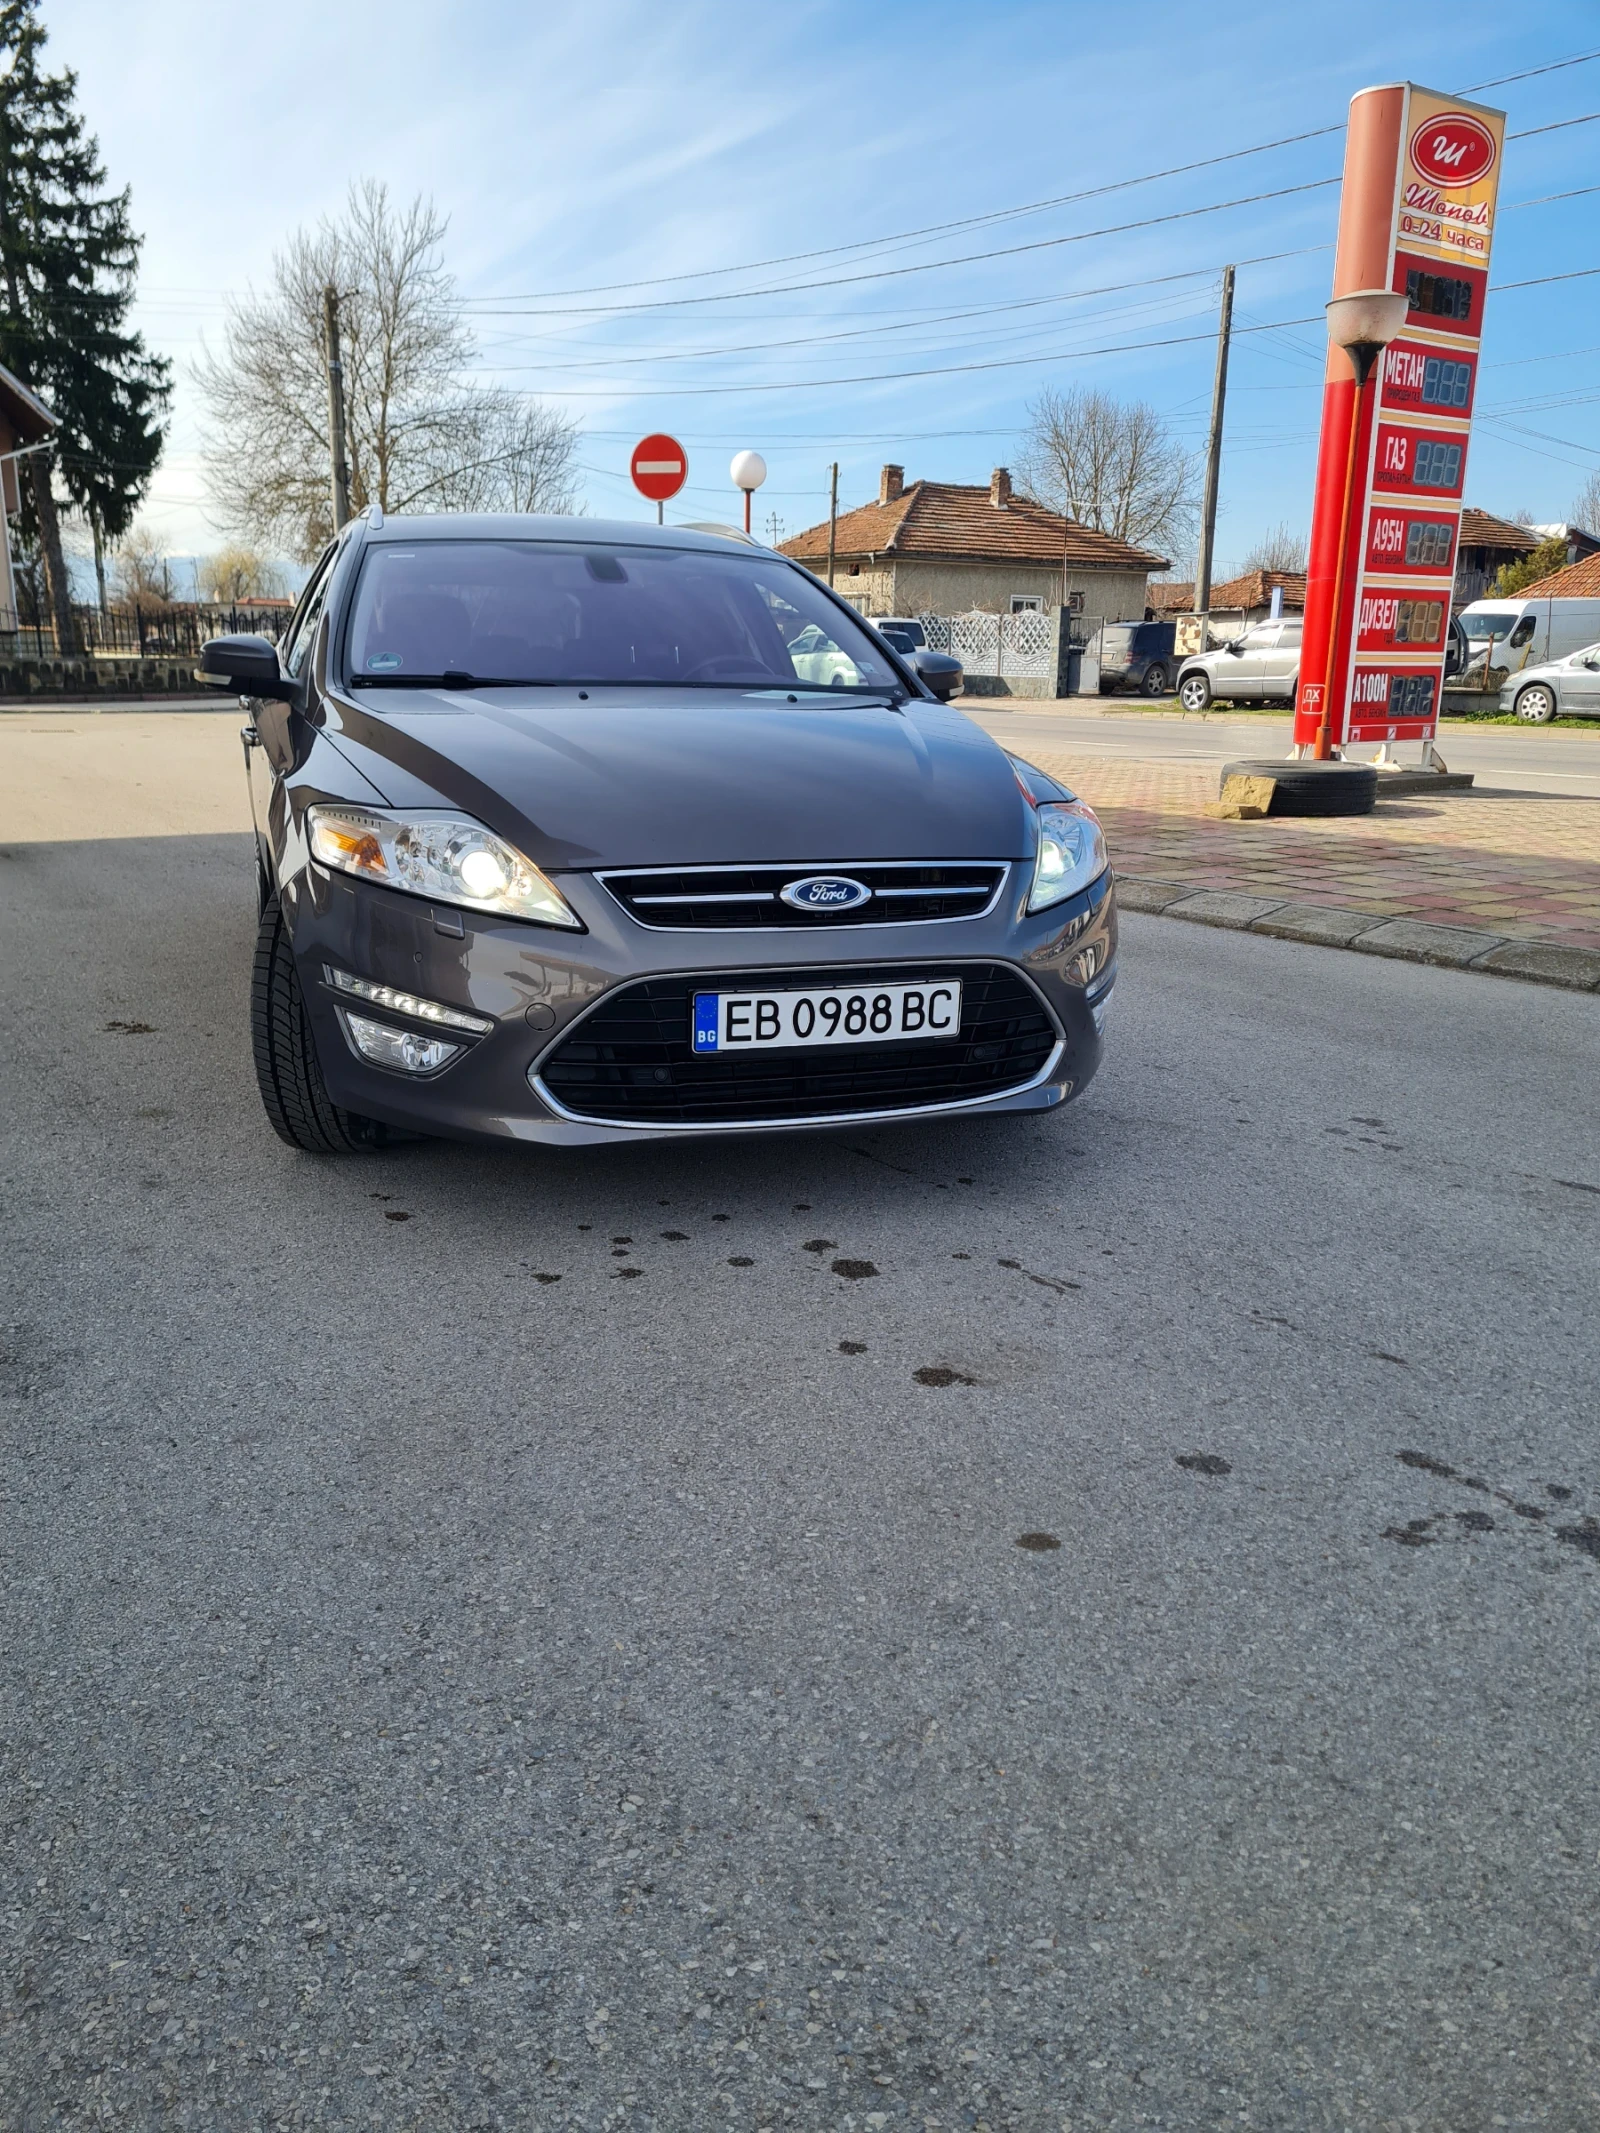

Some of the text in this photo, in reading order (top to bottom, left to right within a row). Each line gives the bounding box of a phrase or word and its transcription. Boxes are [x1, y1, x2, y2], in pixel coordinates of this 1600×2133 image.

[1402, 215, 1484, 251] 0-24 часа
[1385, 349, 1426, 389] МЕТАН
[1384, 436, 1408, 471] ГАЗ
[1372, 518, 1404, 552] А95Н
[1358, 598, 1399, 636] ДИЗЕЛ
[1352, 673, 1388, 703] А100Н
[808, 883, 848, 901] Ford
[725, 989, 953, 1042] EB 0988 BC
[697, 1030, 717, 1043] BG
